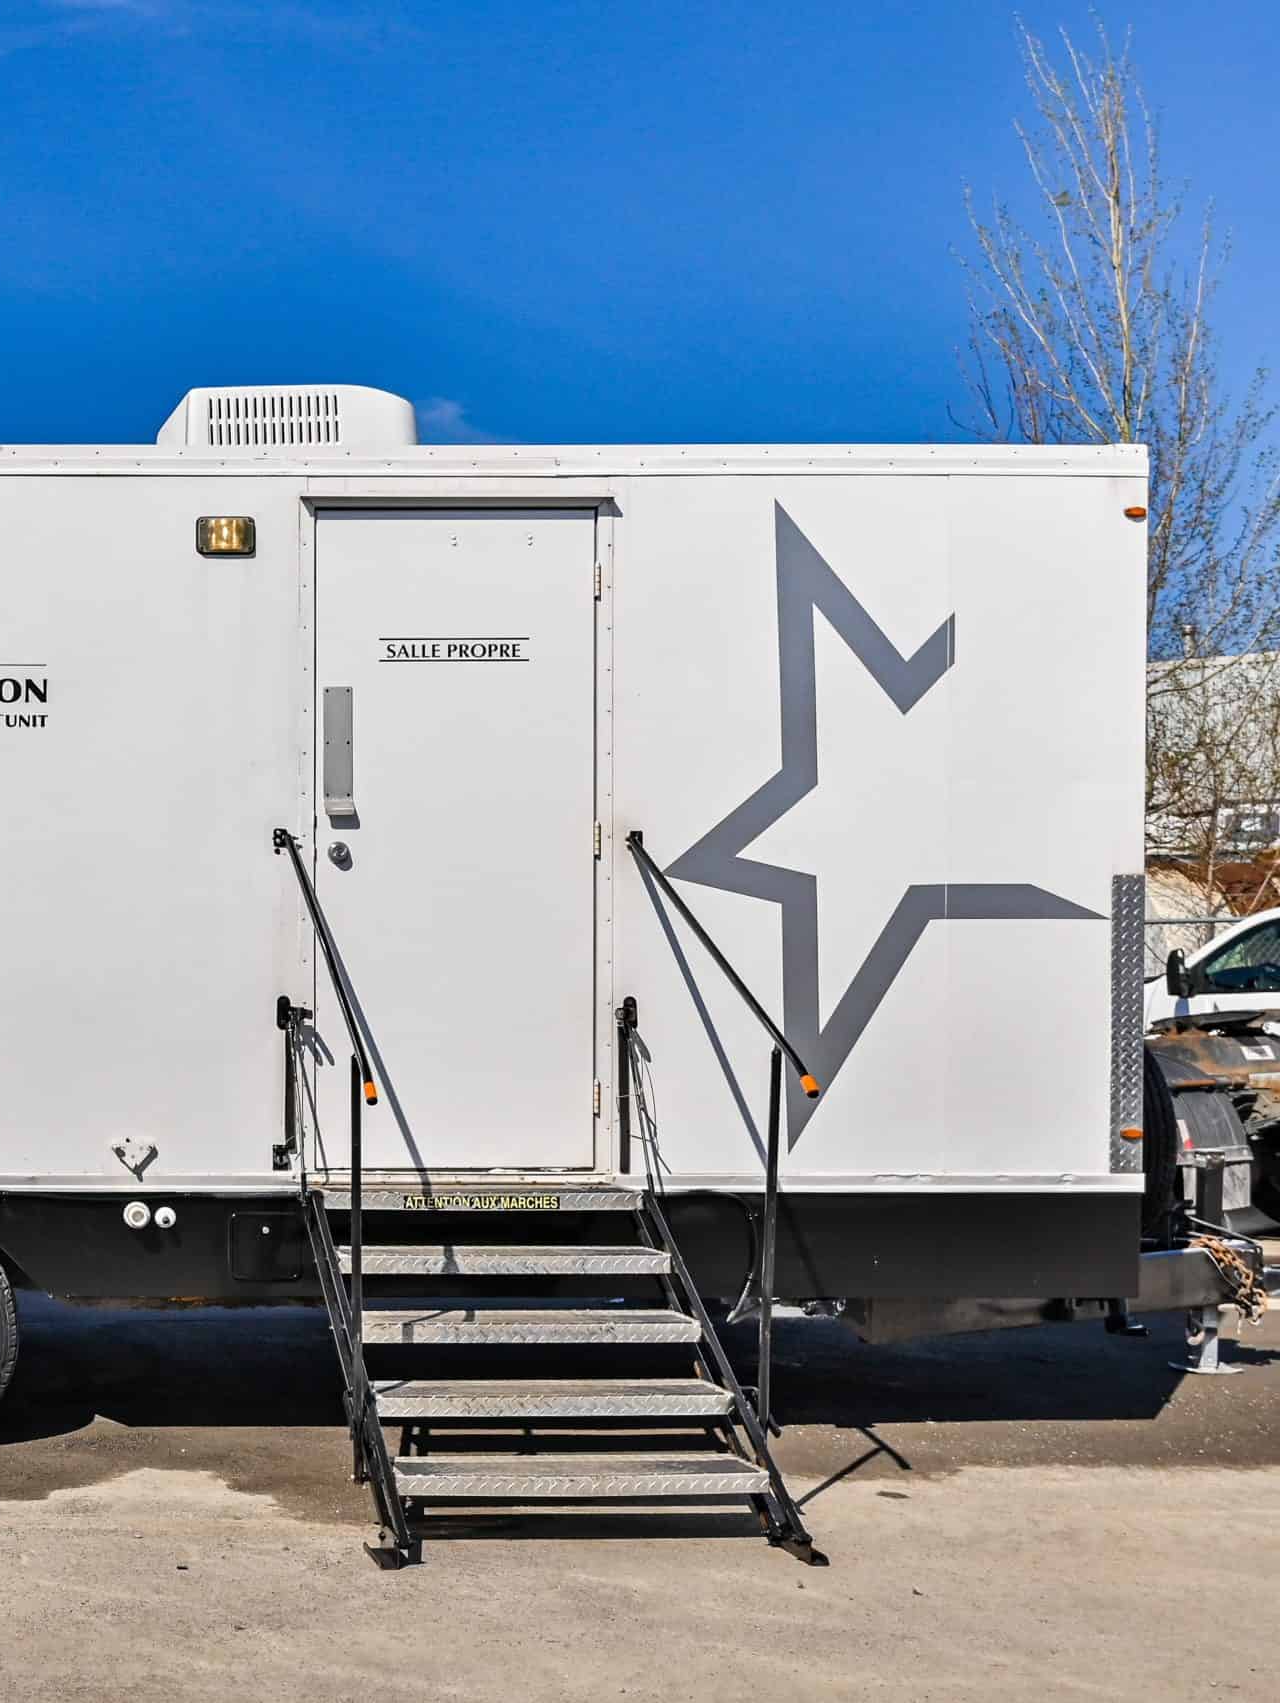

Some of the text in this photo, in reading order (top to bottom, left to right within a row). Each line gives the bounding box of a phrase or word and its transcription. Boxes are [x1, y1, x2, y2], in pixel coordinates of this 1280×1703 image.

[386, 643, 521, 658] SALLE PROPRE
[5, 714, 49, 728] UNIT
[472, 1196, 497, 1209] AUX
[501, 1196, 558, 1209] MARCHES
